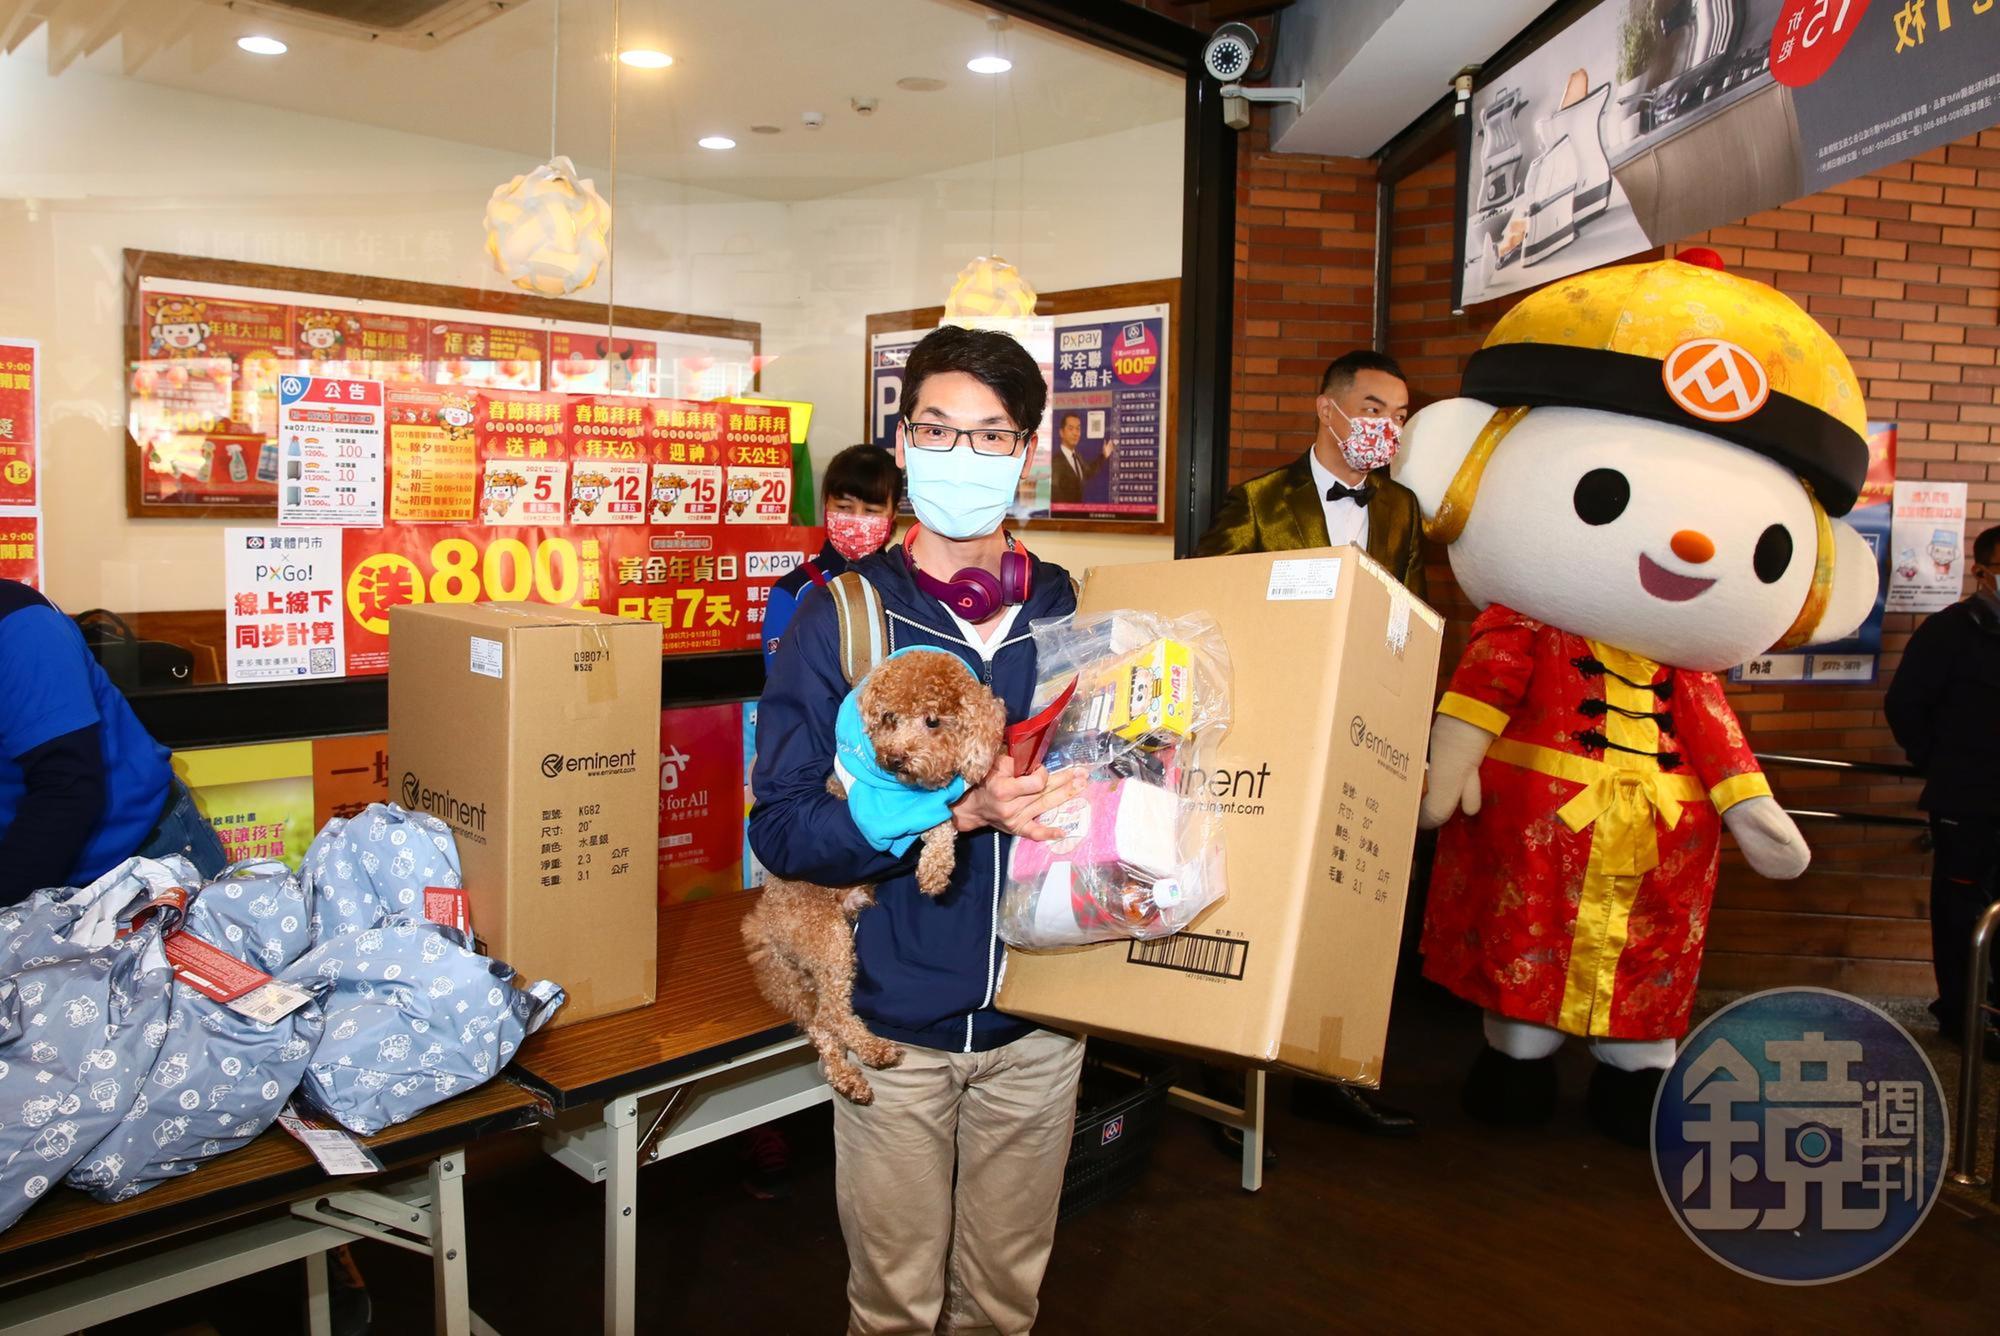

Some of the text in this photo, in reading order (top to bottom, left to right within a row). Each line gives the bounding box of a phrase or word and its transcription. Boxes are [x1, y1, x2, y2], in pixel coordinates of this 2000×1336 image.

[325, 382, 365, 400] 公告
[489, 401, 560, 421] 春節拜拜
[576, 405, 642, 424] 春節拜拜
[656, 410, 717, 428] 春節拜拜
[729, 415, 786, 431] 春節拜拜
[338, 445, 363, 458] 100
[506, 437, 547, 457] 送神
[587, 440, 635, 458] 拜天公
[670, 444, 705, 462] 迎神
[738, 448, 780, 464] 天公生
[338, 469, 355, 481] 10
[534, 476, 552, 500] 5
[614, 476, 639, 500] 12
[691, 478, 715, 501] 15
[762, 480, 785, 502] 20
[338, 494, 355, 506] 10
[270, 537, 322, 549] 實體門市
[430, 538, 579, 604] 800
[618, 556, 738, 585] 黃金年貨日
[234, 590, 334, 616] 線上線下
[236, 621, 335, 649] 同步計算
[566, 749, 636, 771] eminent
[1366, 731, 1410, 773] eminent
[667, 790, 708, 810] for All
[421, 788, 486, 831] eminent
[578, 804, 600, 816] KG82
[579, 834, 609, 848] 水星銀
[577, 853, 592, 865] 2.3
[611, 847, 630, 859] 公斤
[577, 870, 590, 881] 3.1
[611, 863, 629, 875] 公斤
[1377, 869, 1390, 884] 公斤
[1375, 889, 1387, 904] 公斤
